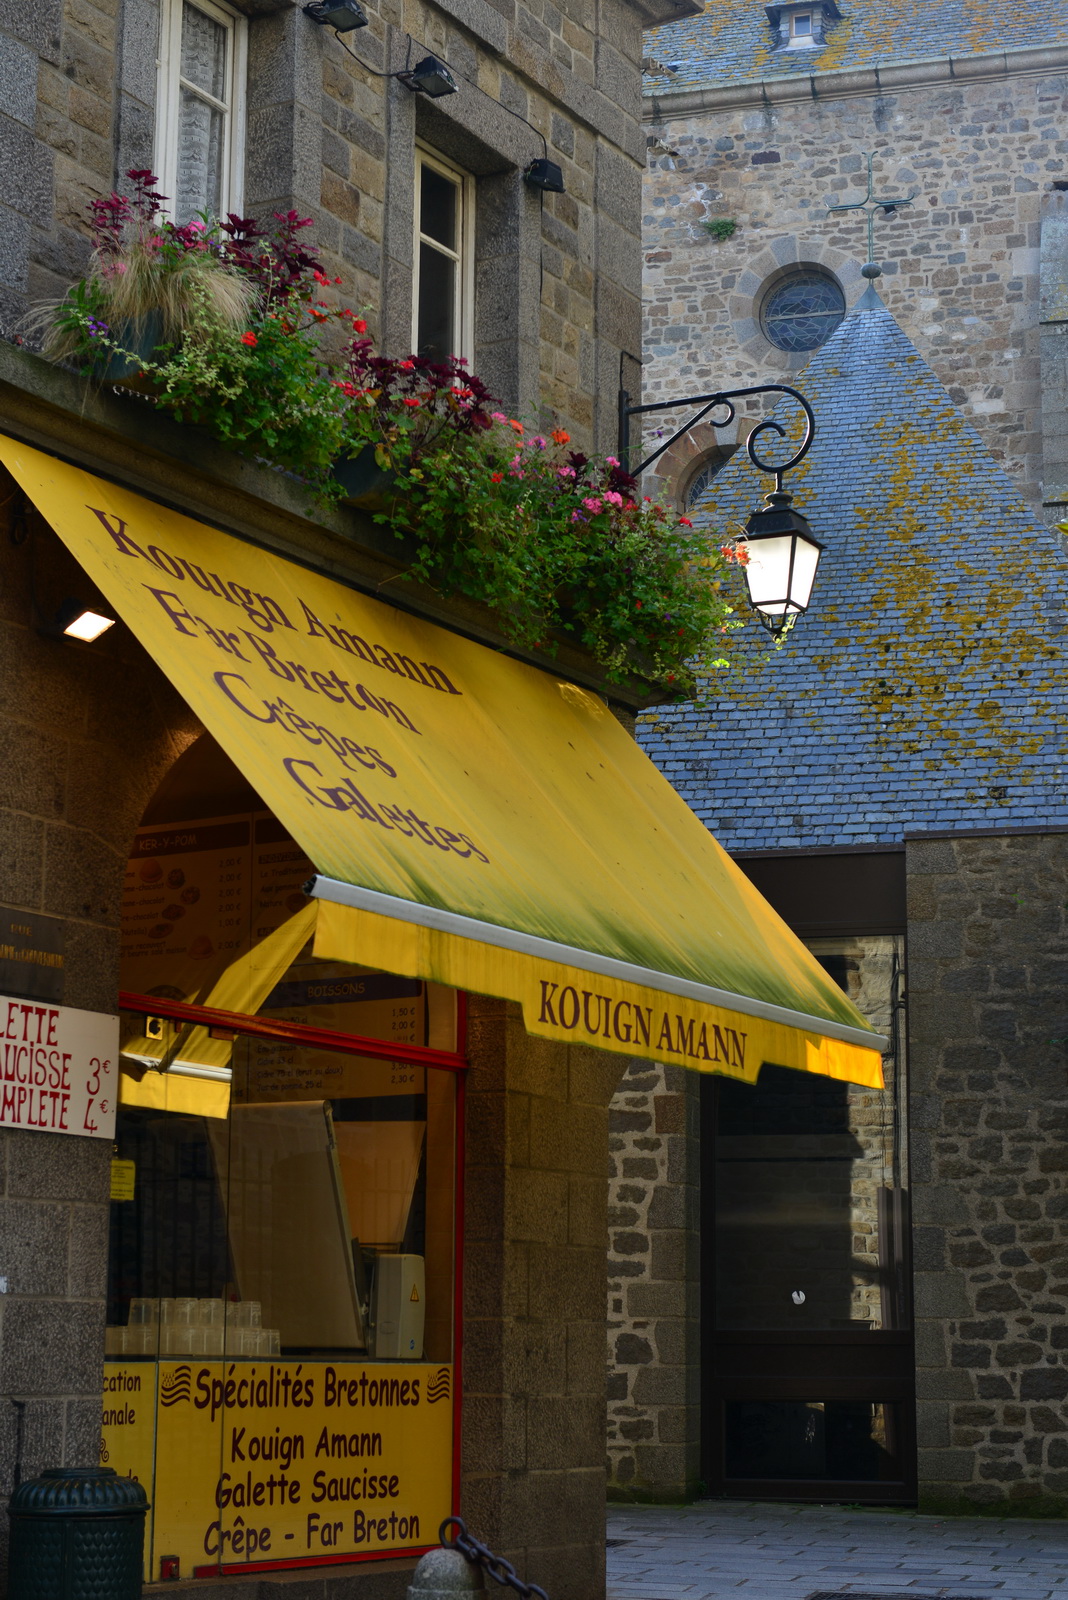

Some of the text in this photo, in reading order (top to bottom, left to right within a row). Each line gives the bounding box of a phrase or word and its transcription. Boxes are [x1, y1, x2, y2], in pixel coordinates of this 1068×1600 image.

[85, 504, 464, 696] Kouign Amann
[141, 582, 423, 736] Far Breton
[213, 671, 398, 778] Crêpes
[283, 757, 491, 864] Galettes
[139, 834, 199, 851] KER-Y-POM
[307, 982, 366, 998] BOISSONS
[537, 979, 748, 1070] KOUIGN AMANN
[194, 1364, 420, 1423] Spécialités Bretonnes
[231, 1425, 382, 1471] Kouign Amann
[215, 1467, 400, 1509] Galette Saucisse
[203, 1515, 272, 1562] Crêpe
[307, 1512, 344, 1550] Far
[353, 1509, 420, 1545] Breton
